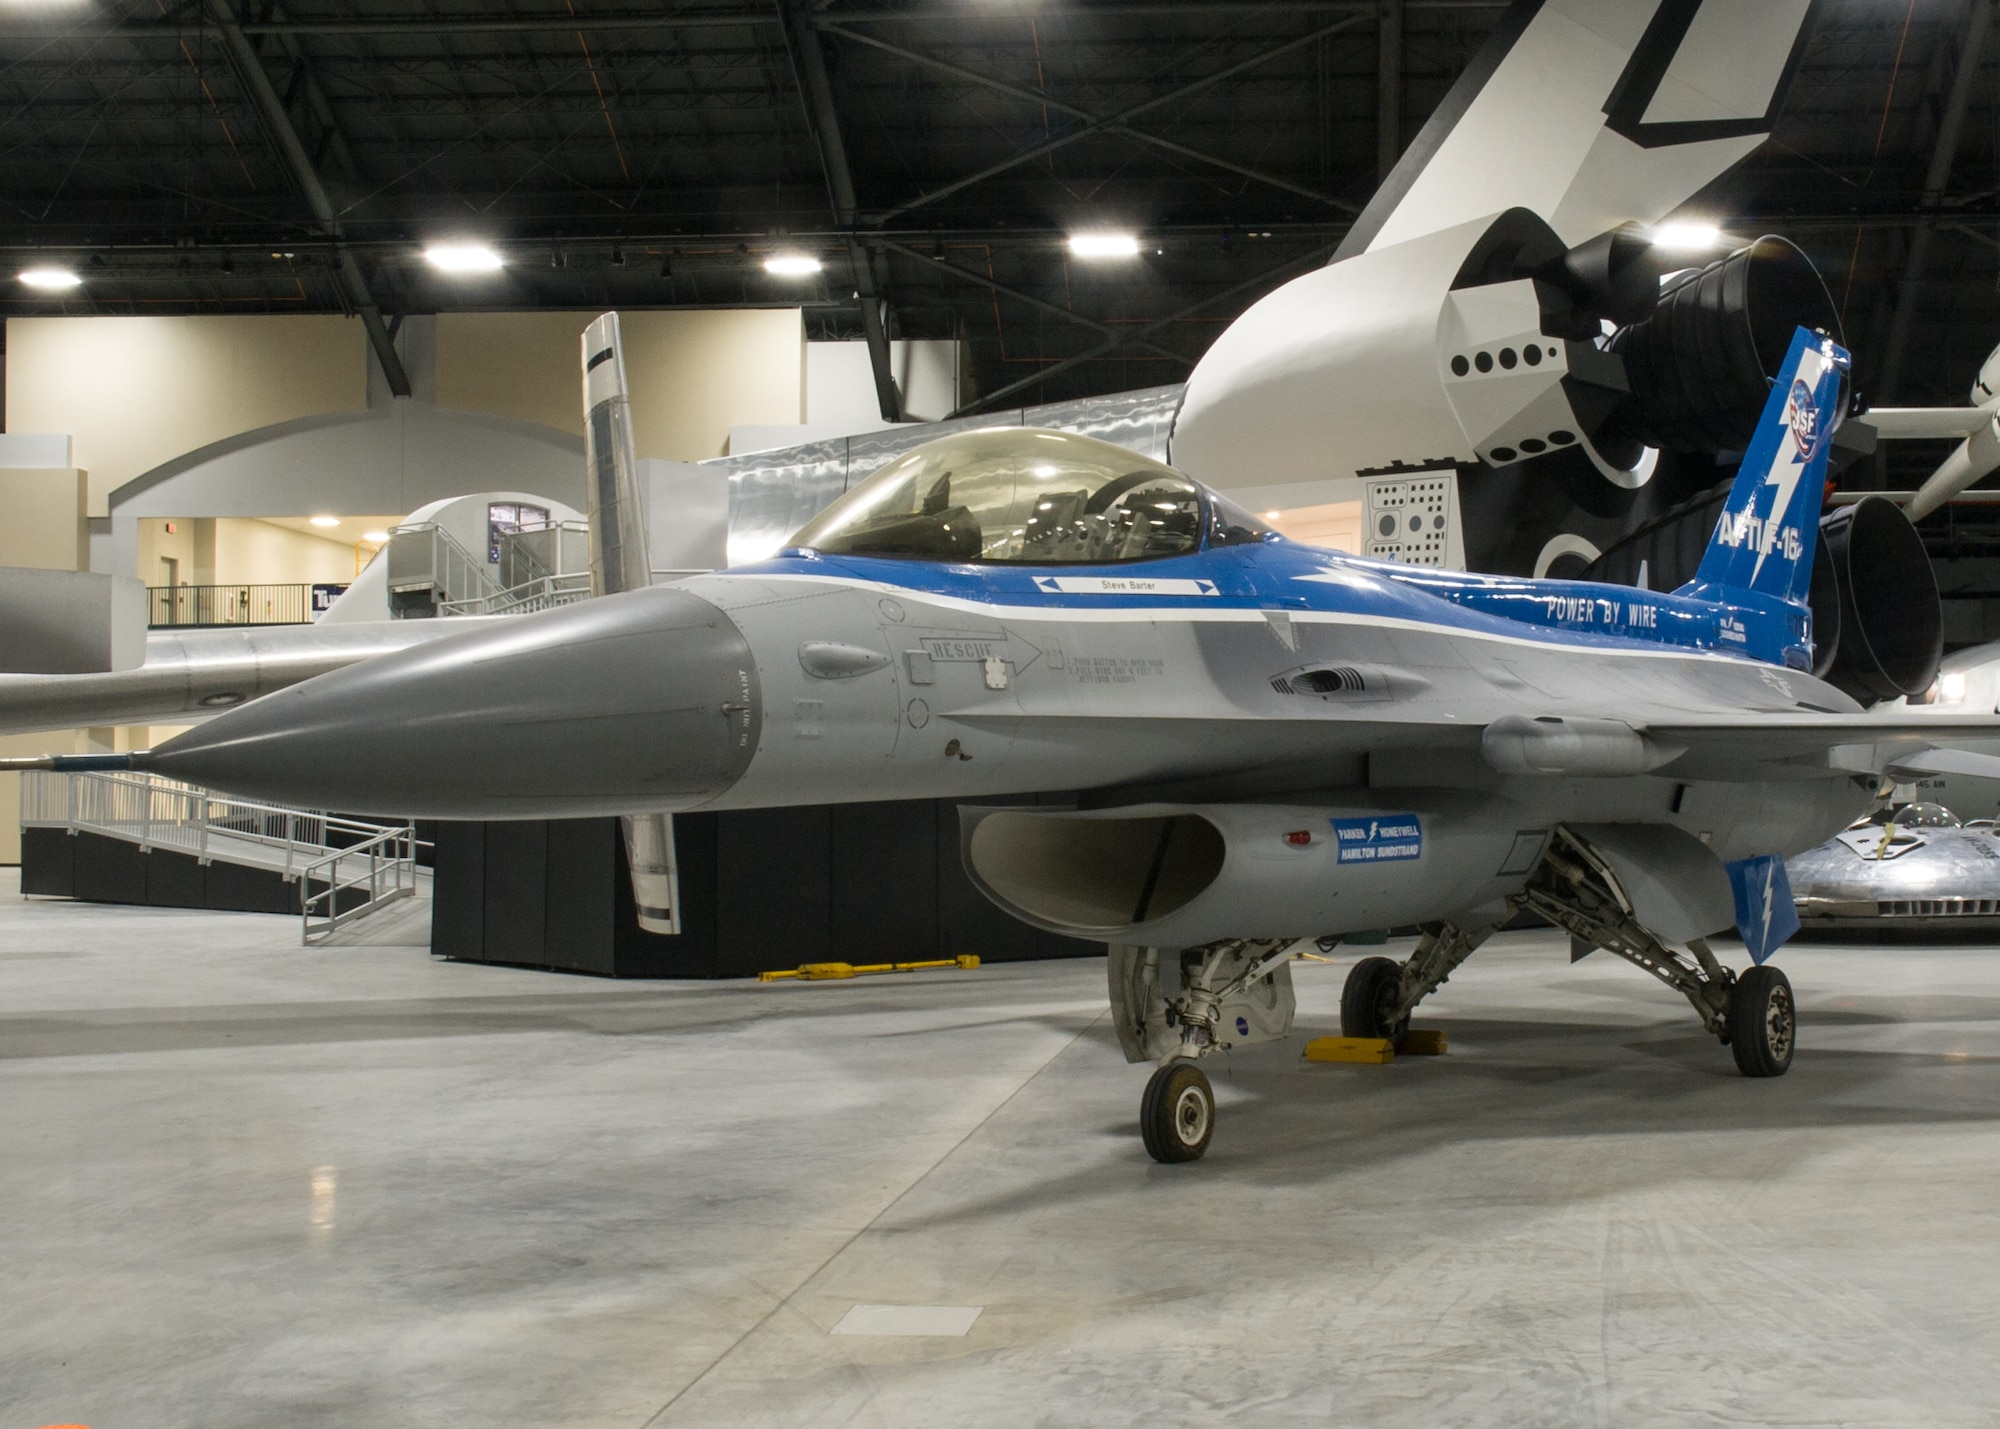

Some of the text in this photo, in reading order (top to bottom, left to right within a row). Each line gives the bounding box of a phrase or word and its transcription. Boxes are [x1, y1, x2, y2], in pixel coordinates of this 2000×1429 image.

[1792, 410, 1815, 433] JSF
[1101, 580, 1156, 590] Steve Barter
[1547, 597, 1657, 628] POWER BY WIRE
[739, 669, 751, 702] PAINT
[1338, 825, 1420, 840] PARKER HONEYWELL
[1341, 844, 1419, 860] HAMILTON SUNDSTRAND
